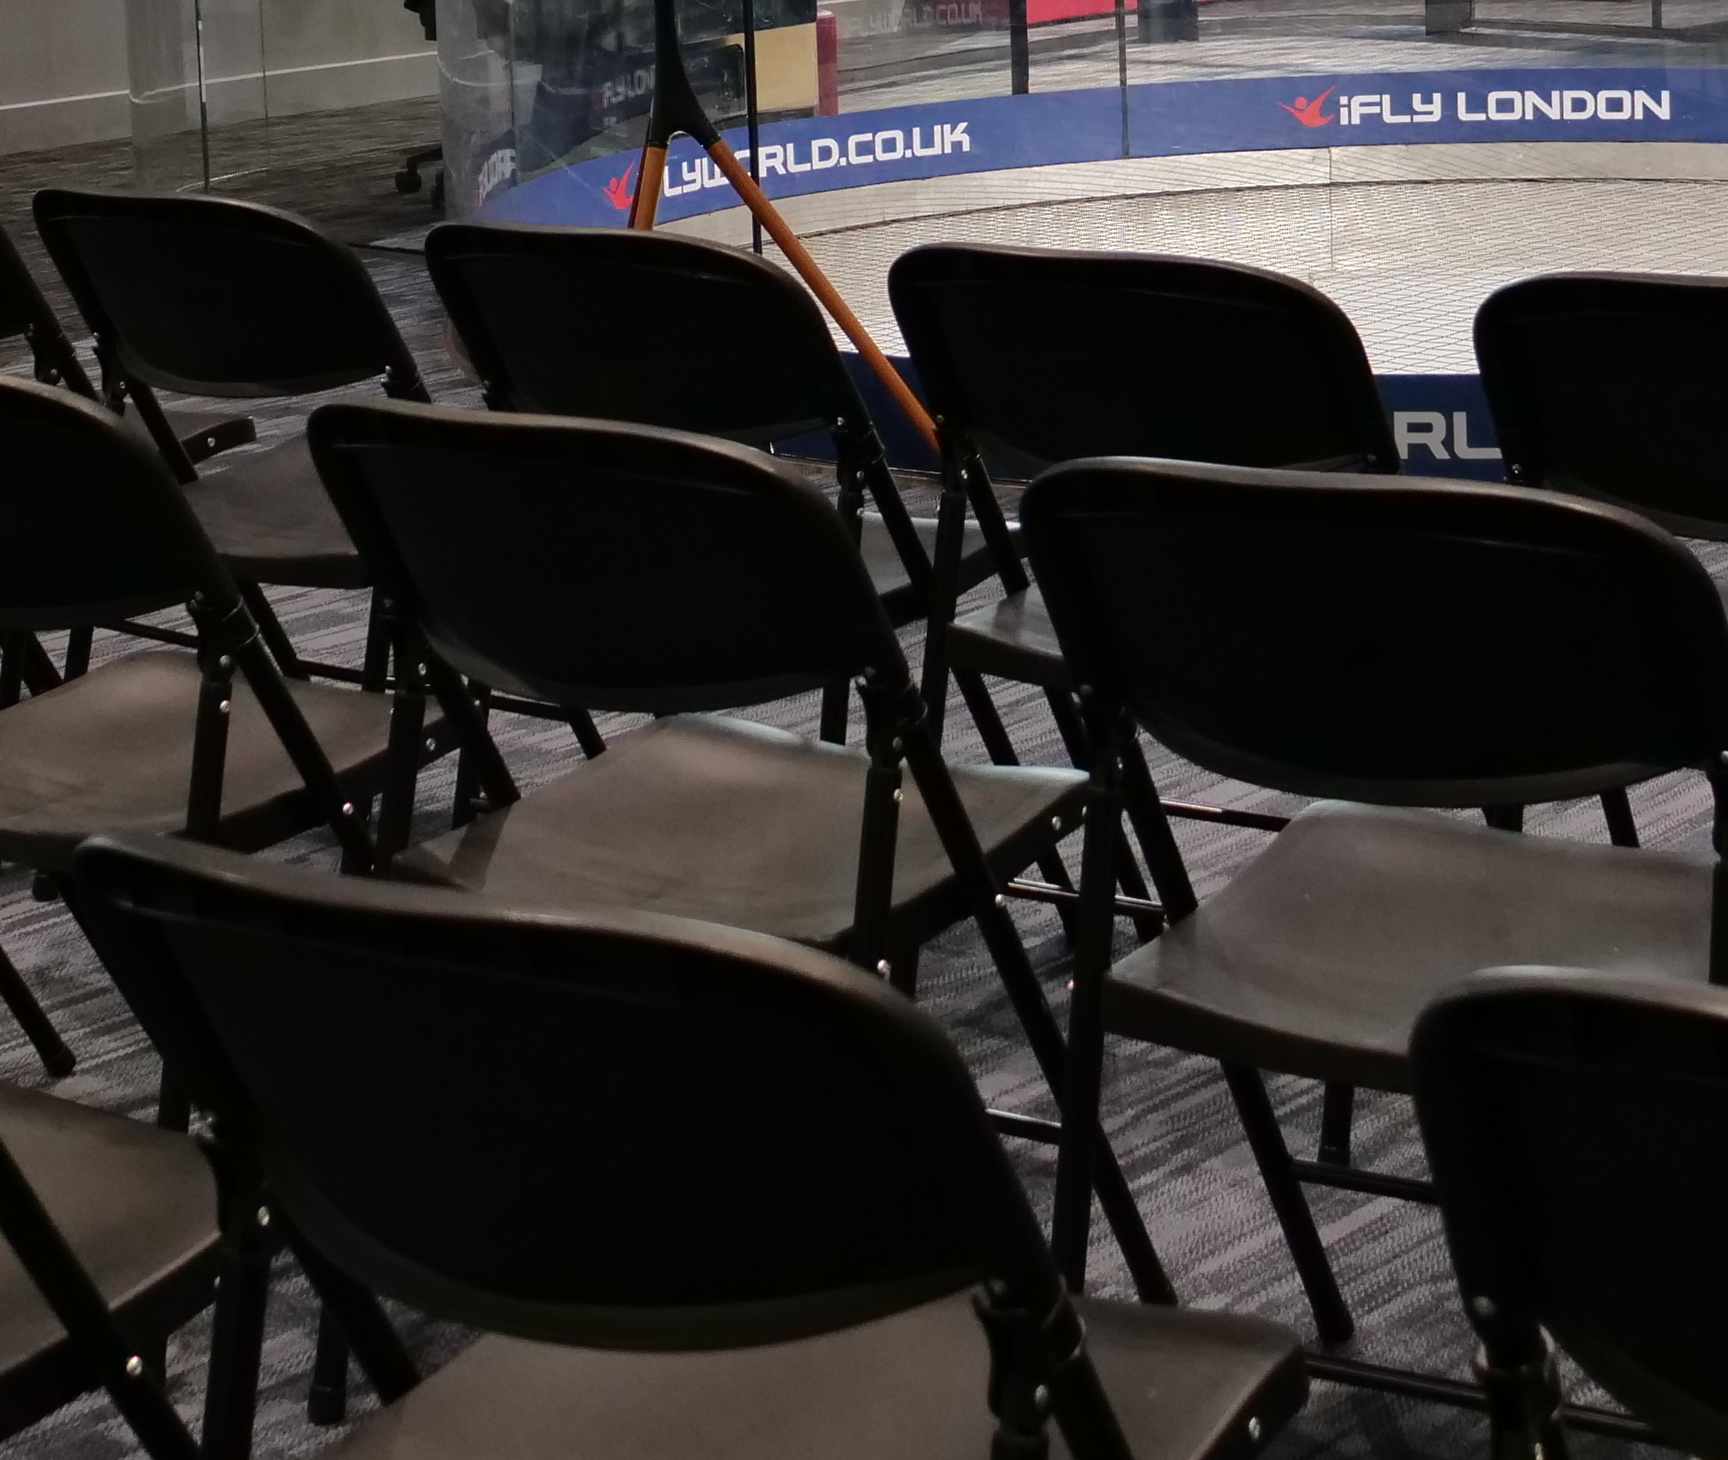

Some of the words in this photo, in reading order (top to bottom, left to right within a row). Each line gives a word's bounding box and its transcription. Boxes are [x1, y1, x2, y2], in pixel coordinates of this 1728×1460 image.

[1339, 93, 1442, 125] iFLY
[1458, 90, 1671, 120] LONDON
[663, 121, 971, 197] LYWRLD.CO.UK
[1393, 411, 1503, 459] RL
